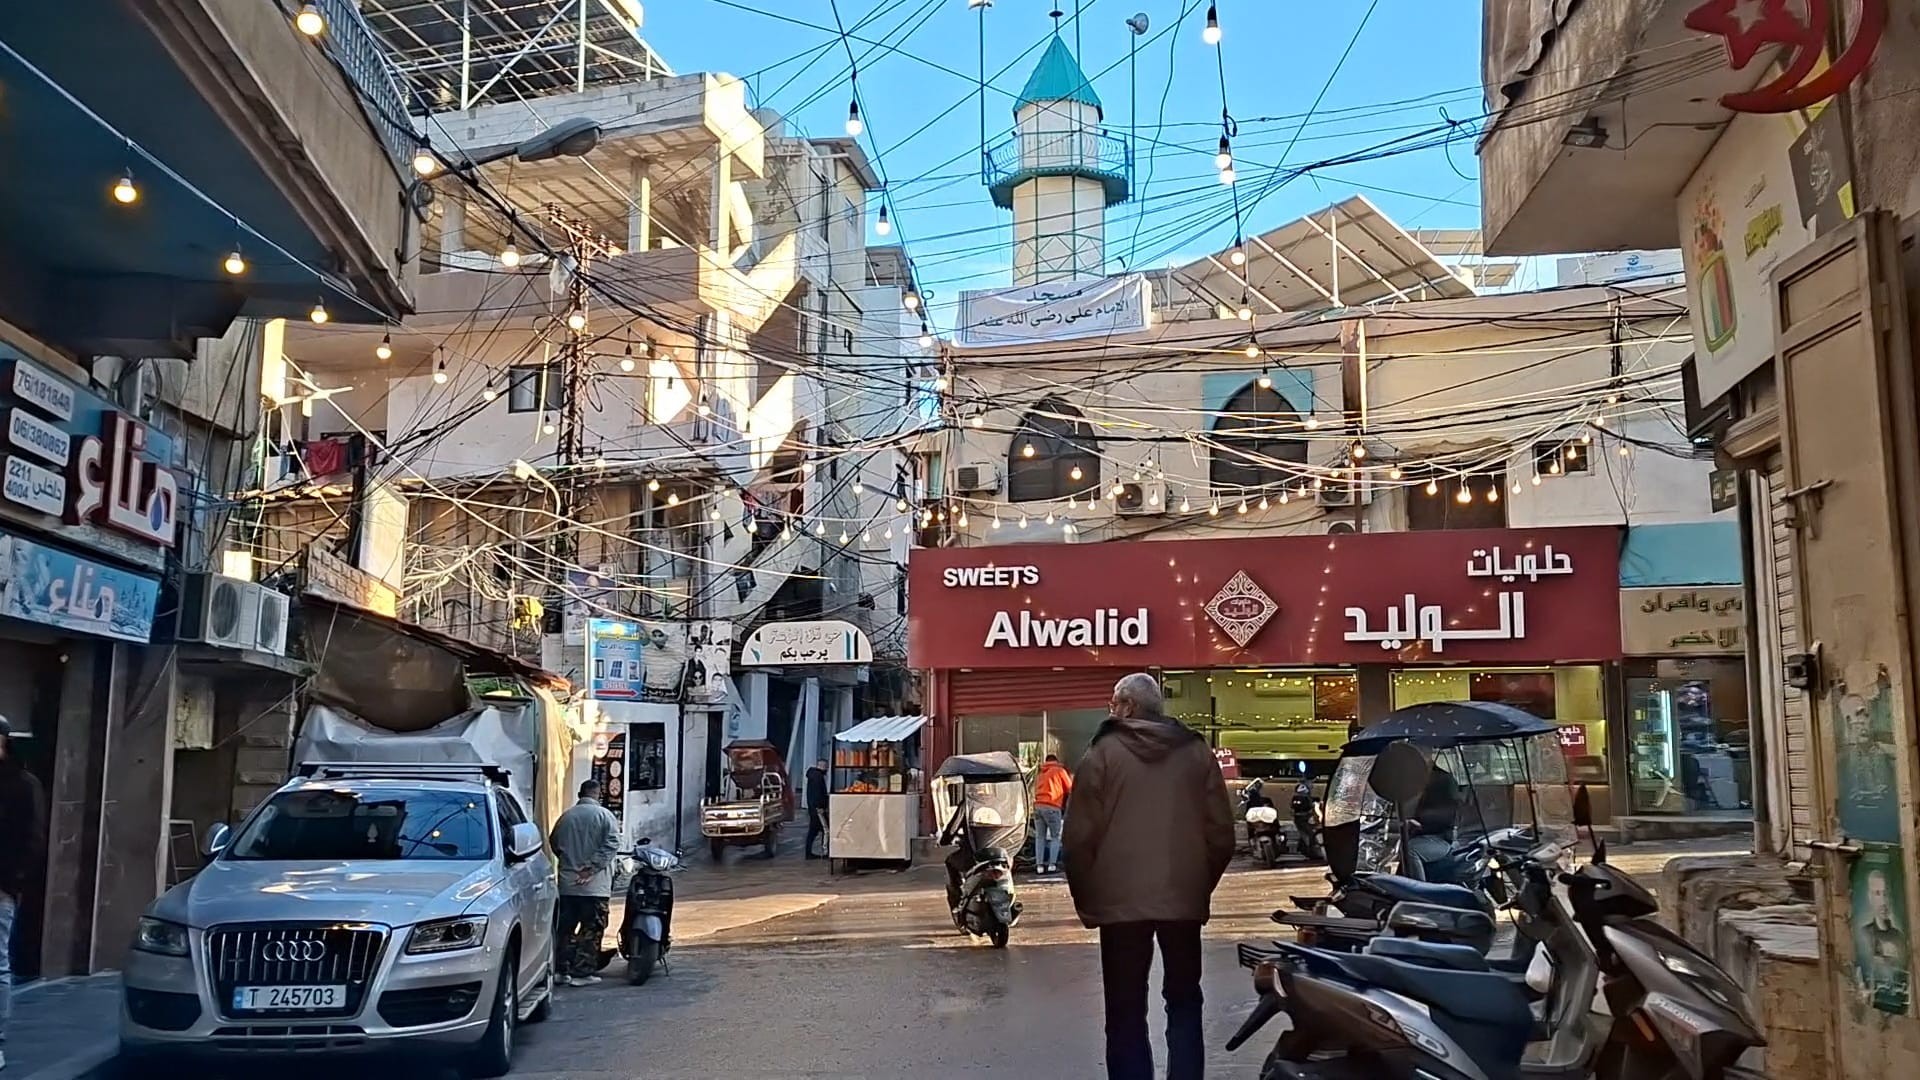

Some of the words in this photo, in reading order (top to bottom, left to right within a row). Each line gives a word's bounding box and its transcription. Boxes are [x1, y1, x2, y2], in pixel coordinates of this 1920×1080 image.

[1026, 289, 1083, 304] مسجد
[8, 459, 32, 482] 2211
[5, 480, 29, 499] 4004
[32, 475, 62, 500] داخلي
[1467, 545, 1574, 582] حلويات
[943, 565, 1039, 587] SWEETS
[984, 608, 1148, 648] Alwalid
[1344, 591, 1525, 653] الوليد
[780, 646, 798, 662] بكم
[800, 648, 829, 662] يرحب
[249, 988, 260, 1007] T
[270, 988, 334, 1006] 245703
